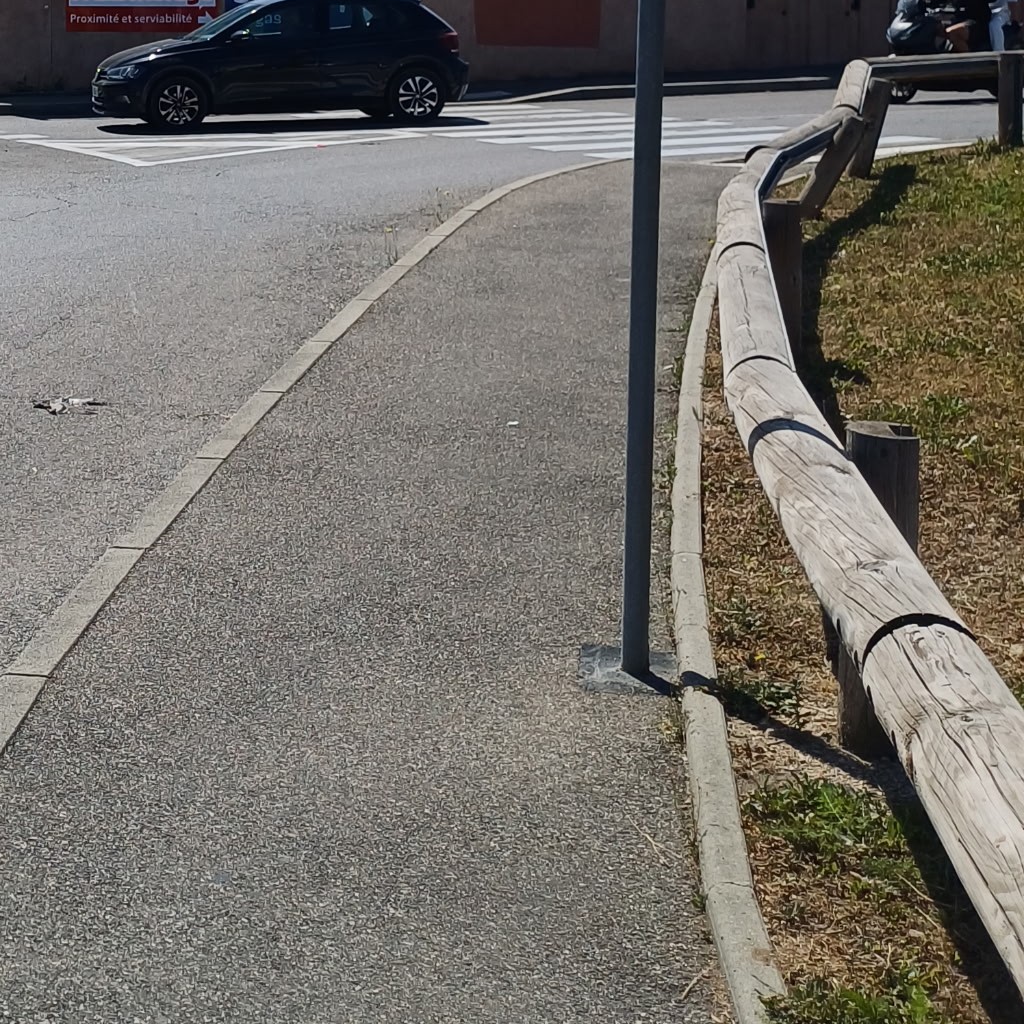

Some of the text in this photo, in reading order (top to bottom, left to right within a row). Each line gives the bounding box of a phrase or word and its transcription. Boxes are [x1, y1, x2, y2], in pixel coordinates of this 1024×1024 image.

[70, 13, 193, 24] Proximité et serviabilité
